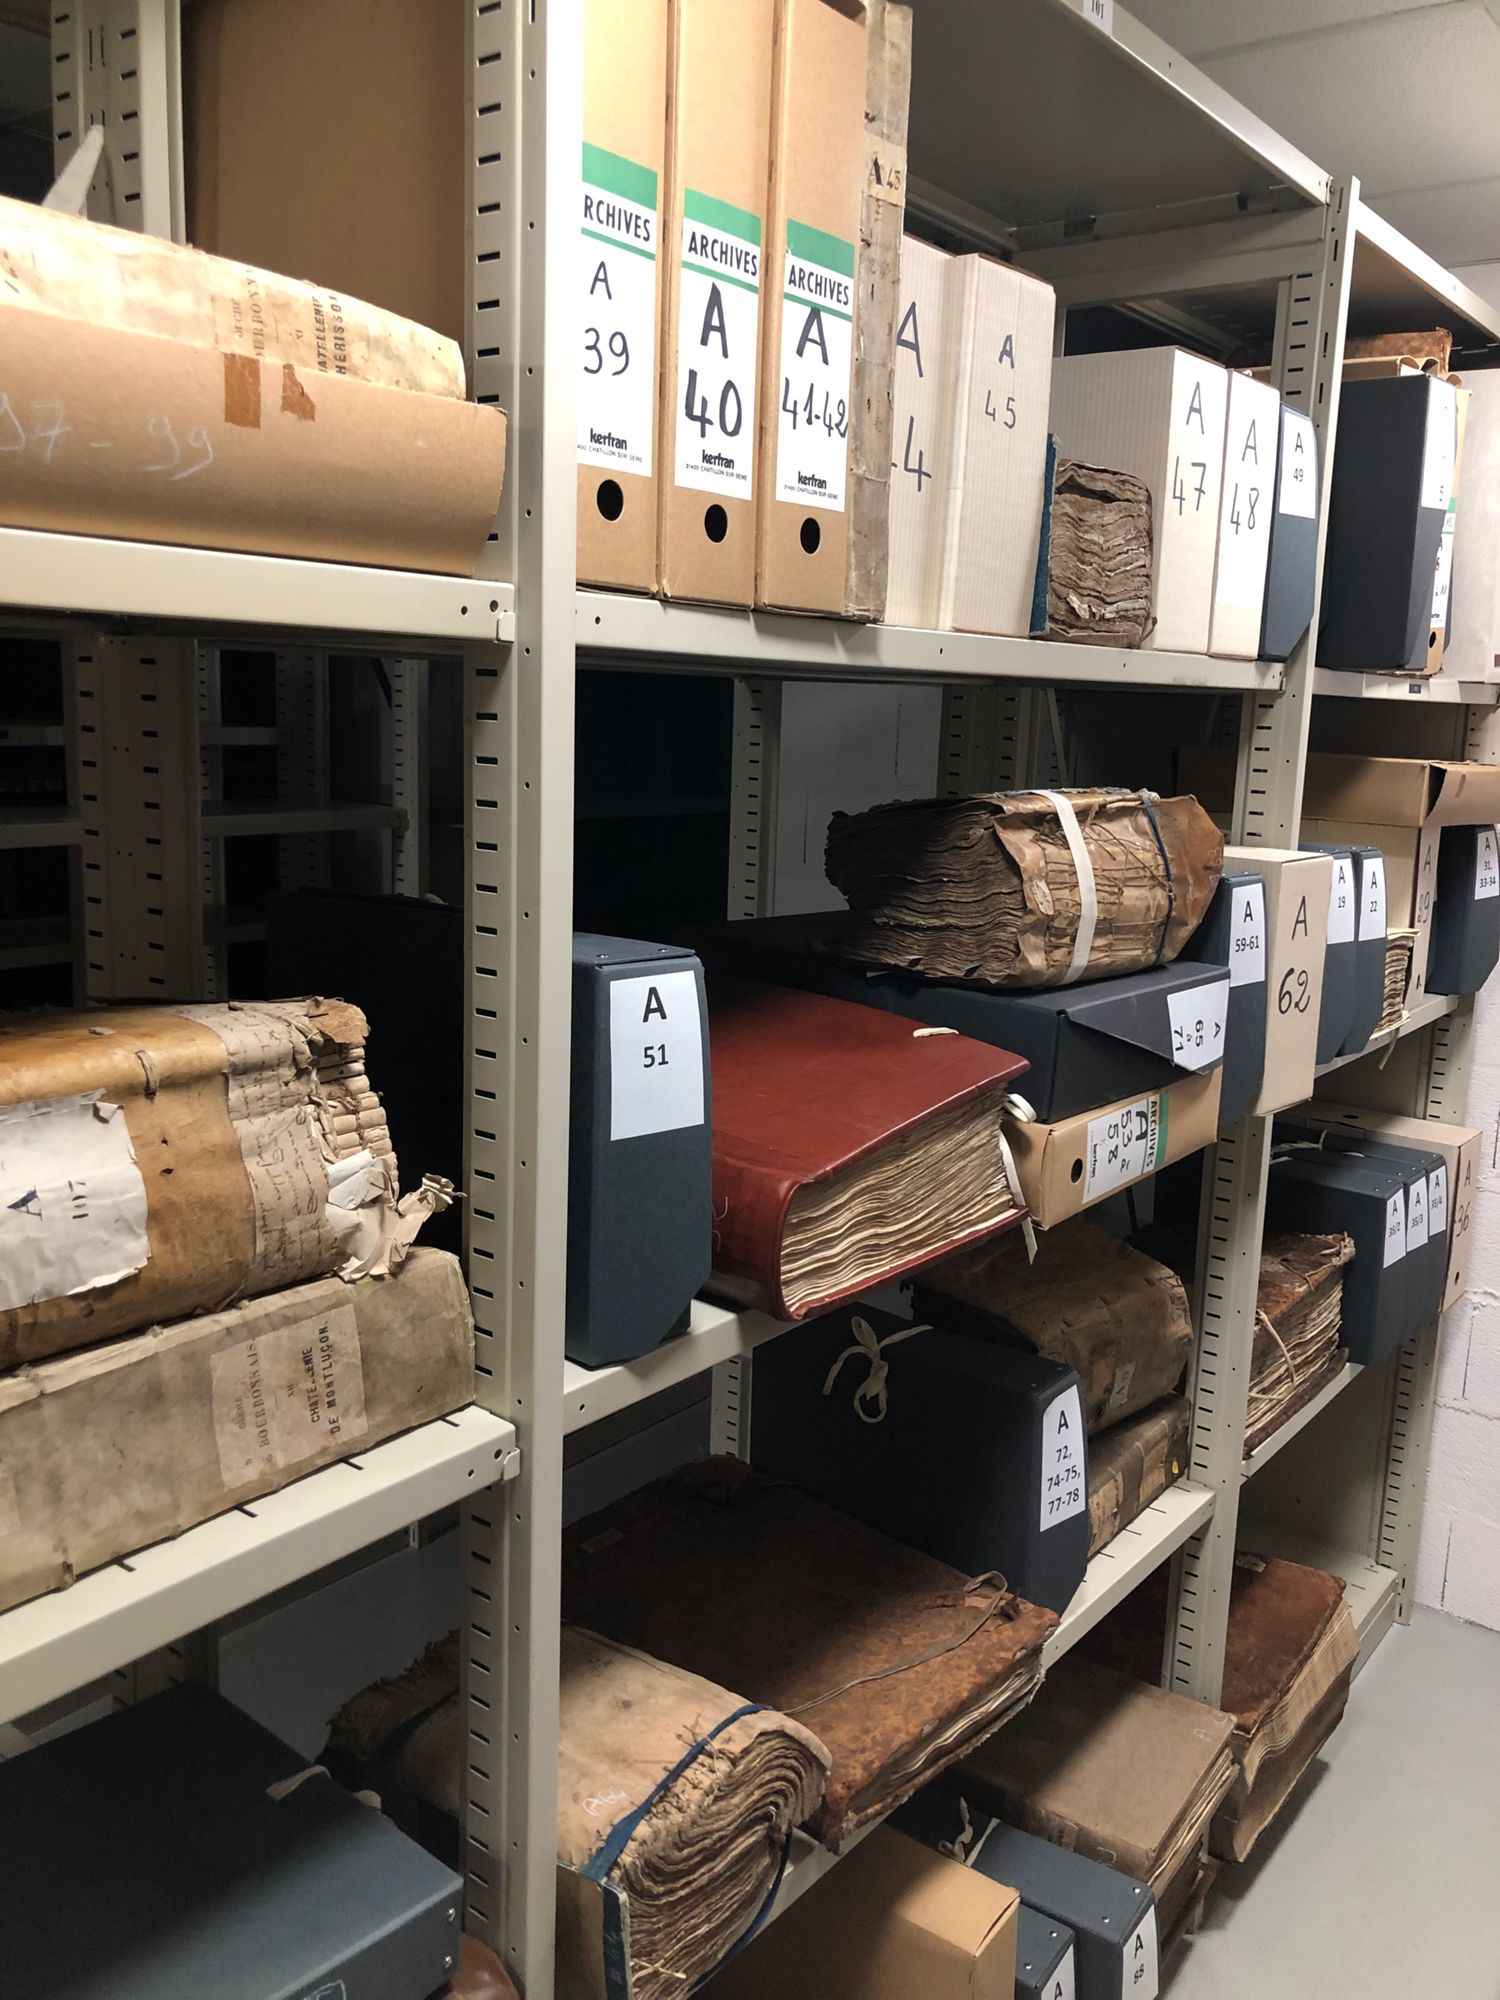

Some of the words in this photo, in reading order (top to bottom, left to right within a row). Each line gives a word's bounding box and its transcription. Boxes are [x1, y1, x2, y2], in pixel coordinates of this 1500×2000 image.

[583, 194, 652, 243] RCHIVES
[688, 231, 759, 277] ARCHIVES
[589, 260, 613, 301] A
[788, 264, 850, 307] ARCHIVES
[699, 281, 730, 359] A
[795, 305, 829, 366] A
[583, 326, 631, 377] 39
[998, 335, 1015, 370] A
[684, 367, 743, 439] 40
[782, 376, 849, 439] 41-42
[984, 390, 1017, 430] 45
[1185, 381, 1204, 435] A
[589, 427, 628, 450] kerfran
[1241, 418, 1258, 466] A
[1294, 431, 1304, 455] A
[702, 449, 735, 470] kerfran
[890, 415, 932, 493] 4
[797, 470, 827, 490] kerfran
[1172, 456, 1207, 516] 47
[1292, 467, 1304, 483] 49
[1230, 482, 1260, 536] 48
[1485, 836, 1492, 851] A
[1422, 844, 1432, 875] A
[1337, 865, 1347, 885] A
[1369, 870, 1378, 890] A
[1243, 900, 1254, 923] A
[1337, 896, 1347, 909] 19
[1369, 901, 1378, 913] 22
[1290, 895, 1309, 941] A
[1234, 935, 1260, 953] 59-61
[642, 986, 668, 1023] A
[1277, 967, 1311, 1015] 62
[1173, 1025, 1185, 1052] 71
[1195, 1019, 1204, 1047] 65
[1213, 1021, 1222, 1039] A
[643, 1043, 669, 1068] 51
[1121, 1109, 1133, 1148] 53
[1135, 1110, 1149, 1142] A
[1146, 1100, 1158, 1167] ARCHIVES
[1107, 1122, 1119, 1165] 58
[1434, 1173, 1440, 1190] A
[1463, 1159, 1471, 1188] A
[6, 1183, 43, 1222] A
[1391, 1199, 1399, 1217] A
[1414, 1191, 1421, 1208] A
[302, 1346, 321, 1424] CHATEENIE
[328, 1416, 341, 1435] DE
[1057, 1409, 1069, 1434] A
[1055, 1444, 1072, 1464] 72,
[1046, 1464, 1081, 1492] 74-75,
[1047, 1487, 1080, 1516] 77-78
[1134, 1932, 1144, 1960] A
